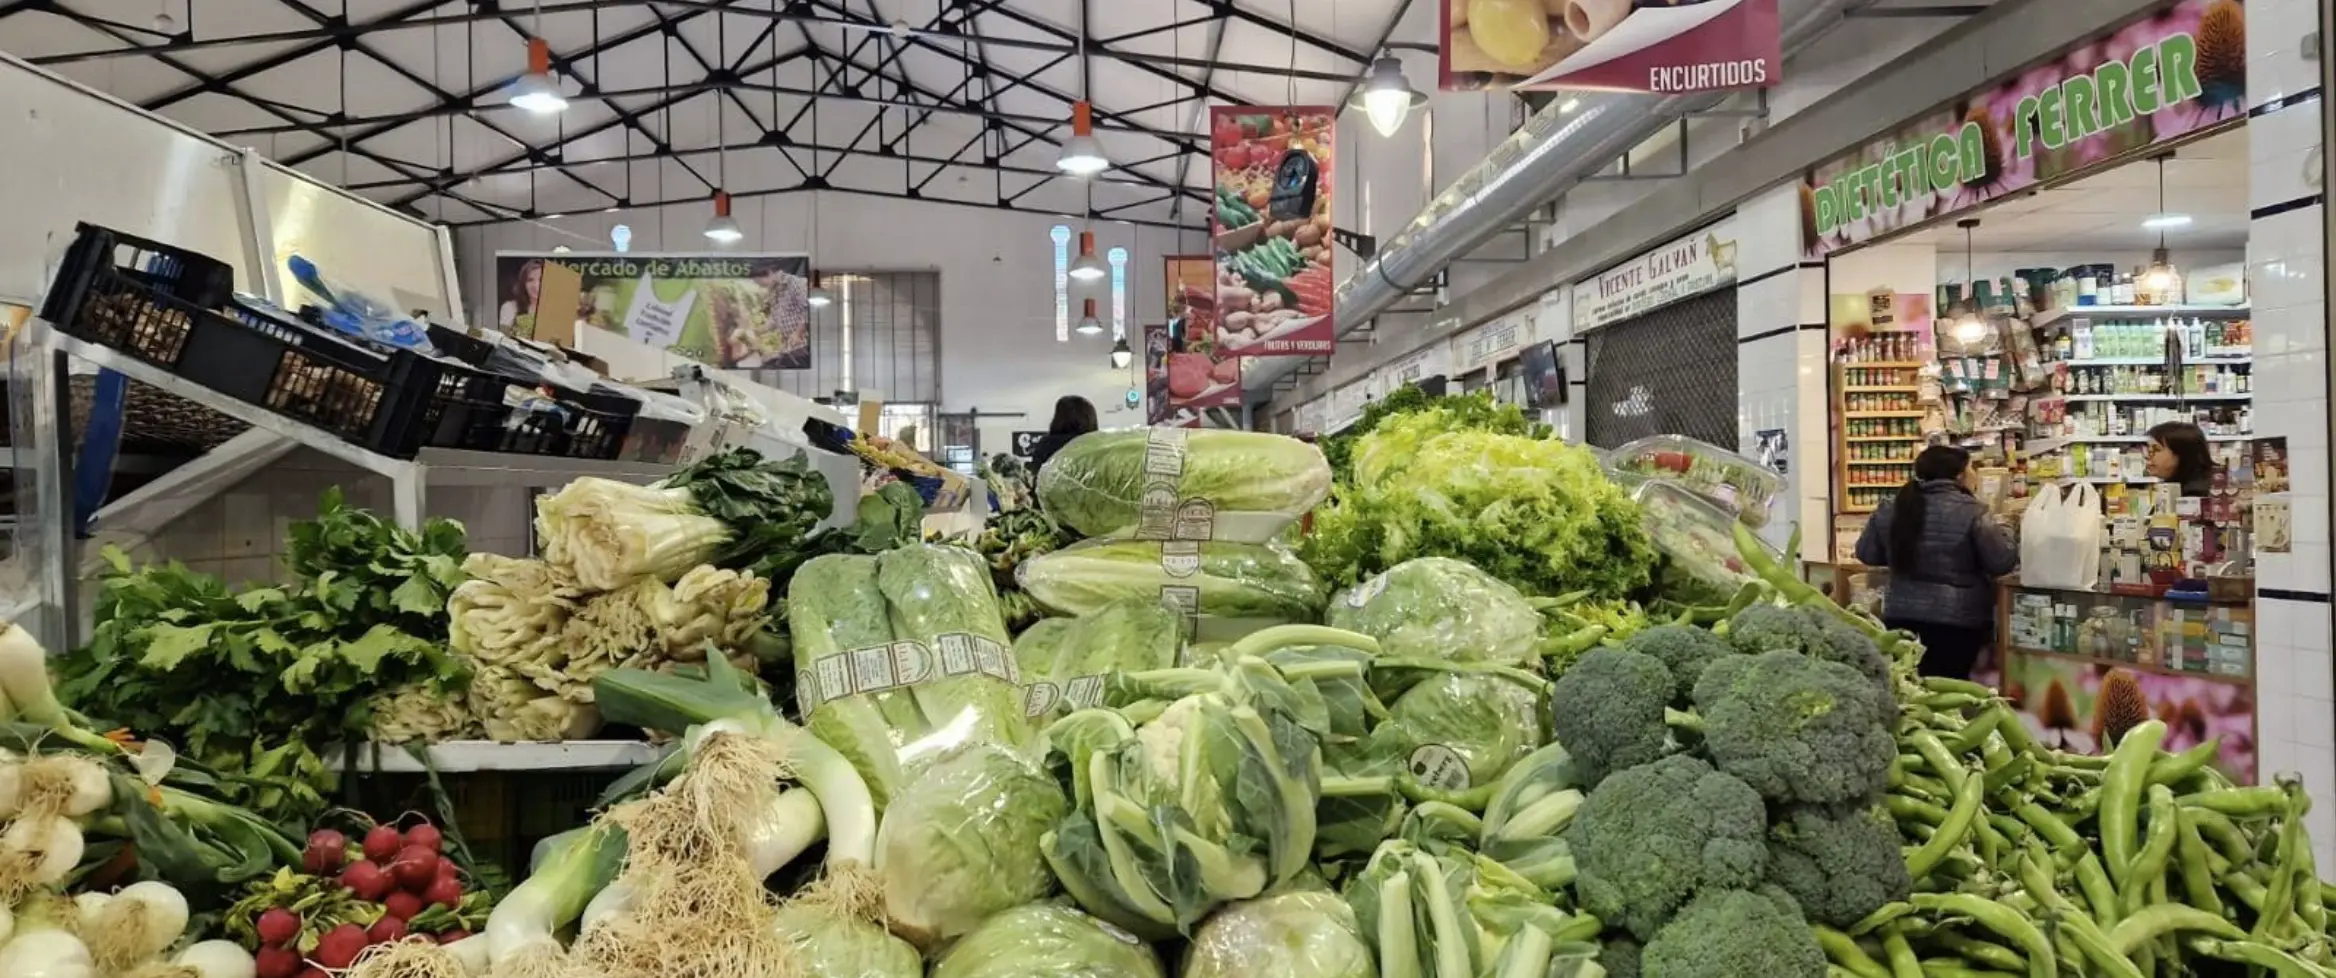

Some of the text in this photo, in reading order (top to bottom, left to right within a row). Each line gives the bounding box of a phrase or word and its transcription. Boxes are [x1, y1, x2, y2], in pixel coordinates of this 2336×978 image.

[1649, 58, 1766, 92] ENCURTIDOS
[1813, 32, 2203, 235] DIETÉTICA FERRER
[646, 259, 669, 276] de
[675, 259, 751, 276] Abastos
[1598, 266, 1643, 299] VICENTE
